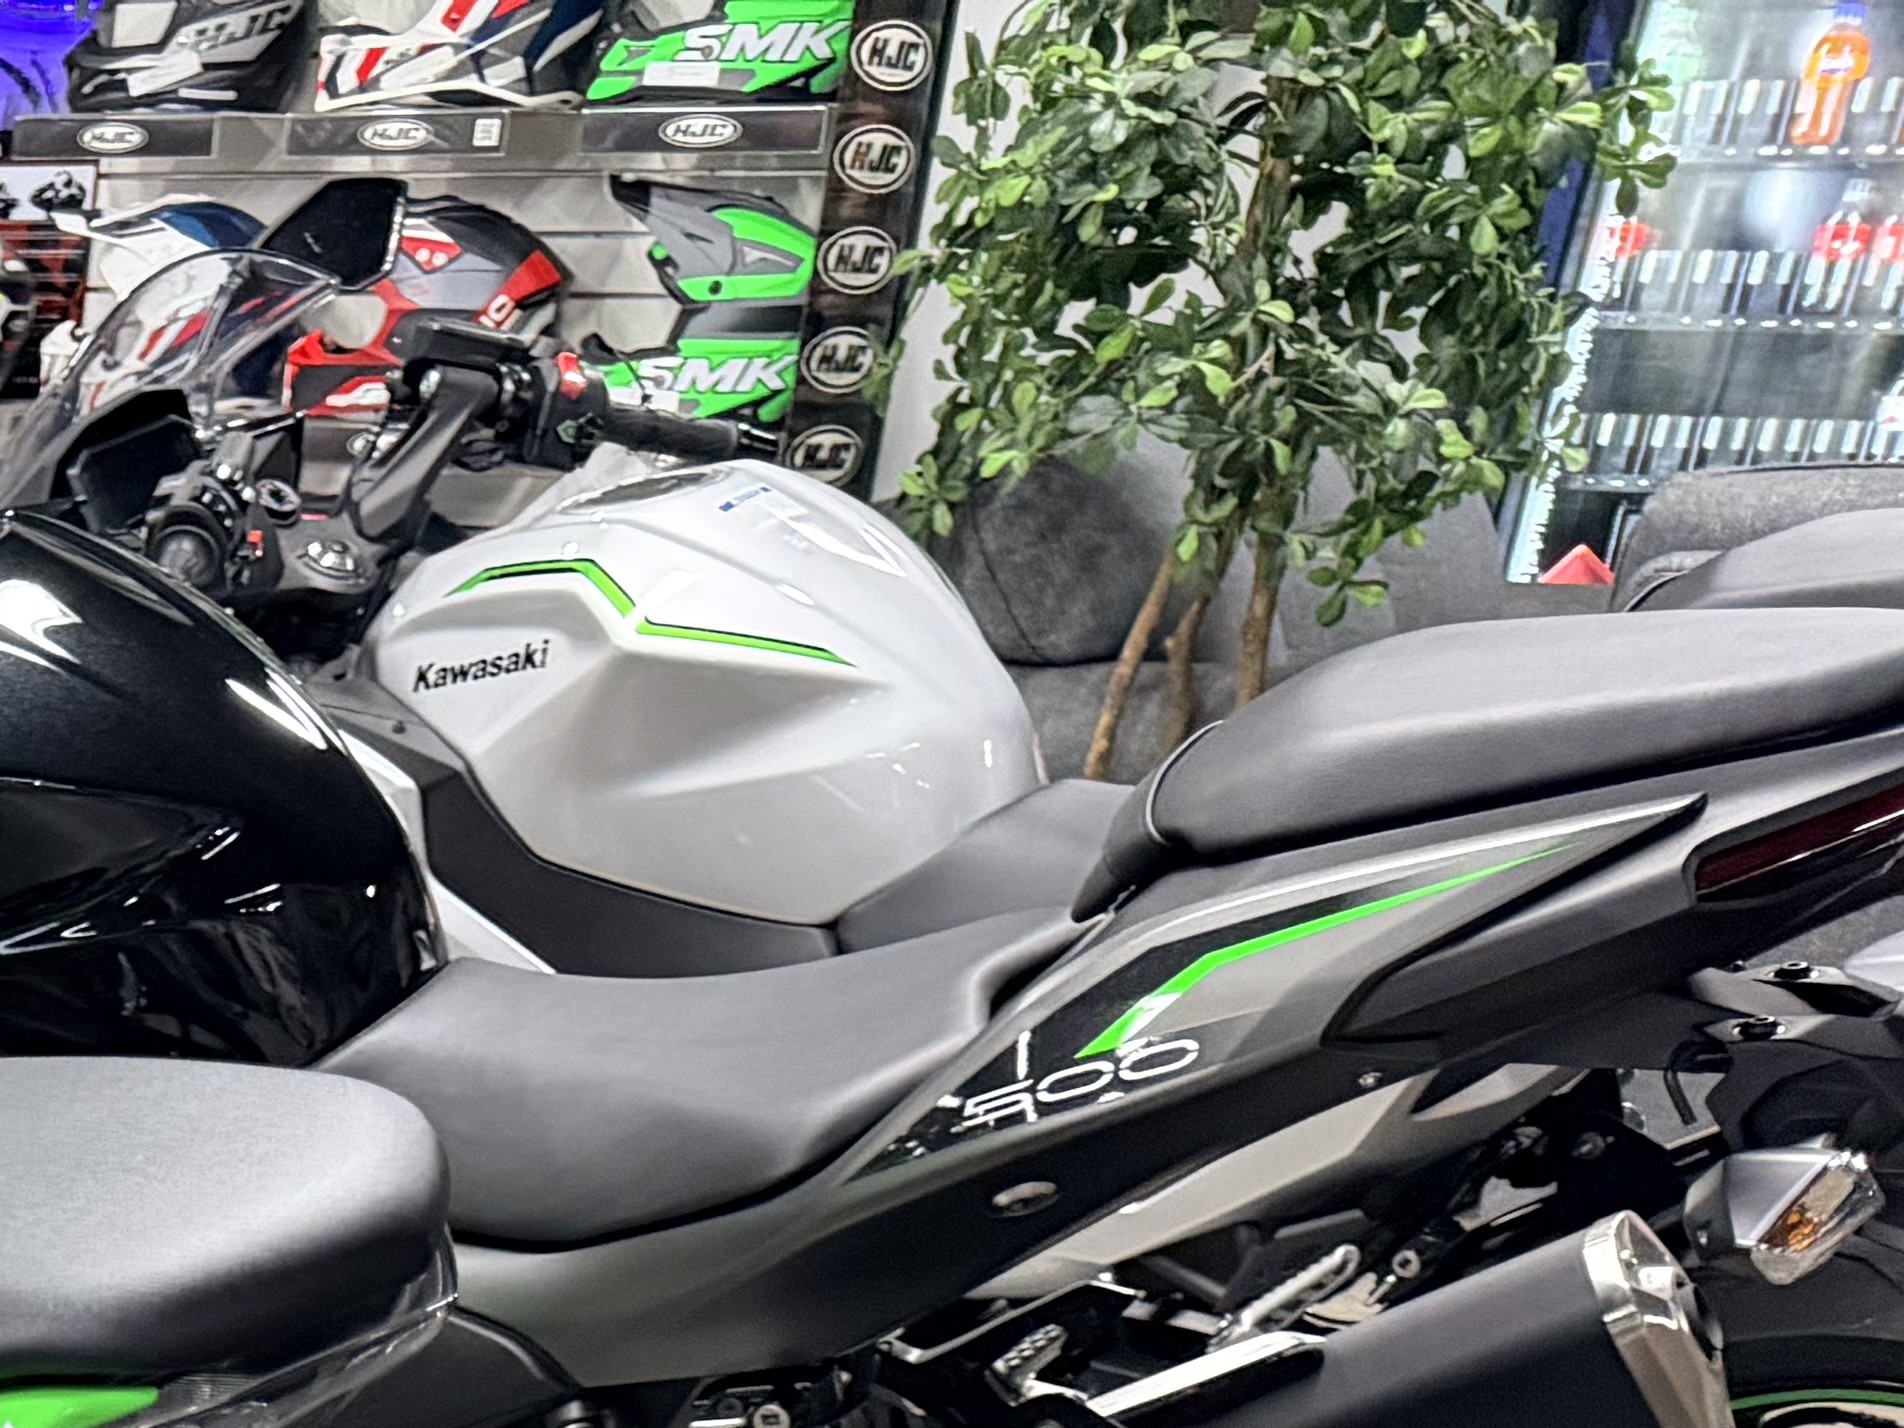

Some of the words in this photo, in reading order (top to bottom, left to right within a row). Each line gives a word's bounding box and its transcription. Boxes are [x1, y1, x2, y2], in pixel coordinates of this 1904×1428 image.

[676, 21, 853, 62] SMK
[868, 36, 923, 72] HJC
[673, 123, 729, 138] HJC
[849, 141, 904, 174] HJC
[833, 243, 885, 274] HJC
[638, 355, 799, 393] SMK
[815, 344, 868, 373] HJC
[411, 638, 553, 694] Kawasaki
[950, 1037, 1200, 1130] 500
